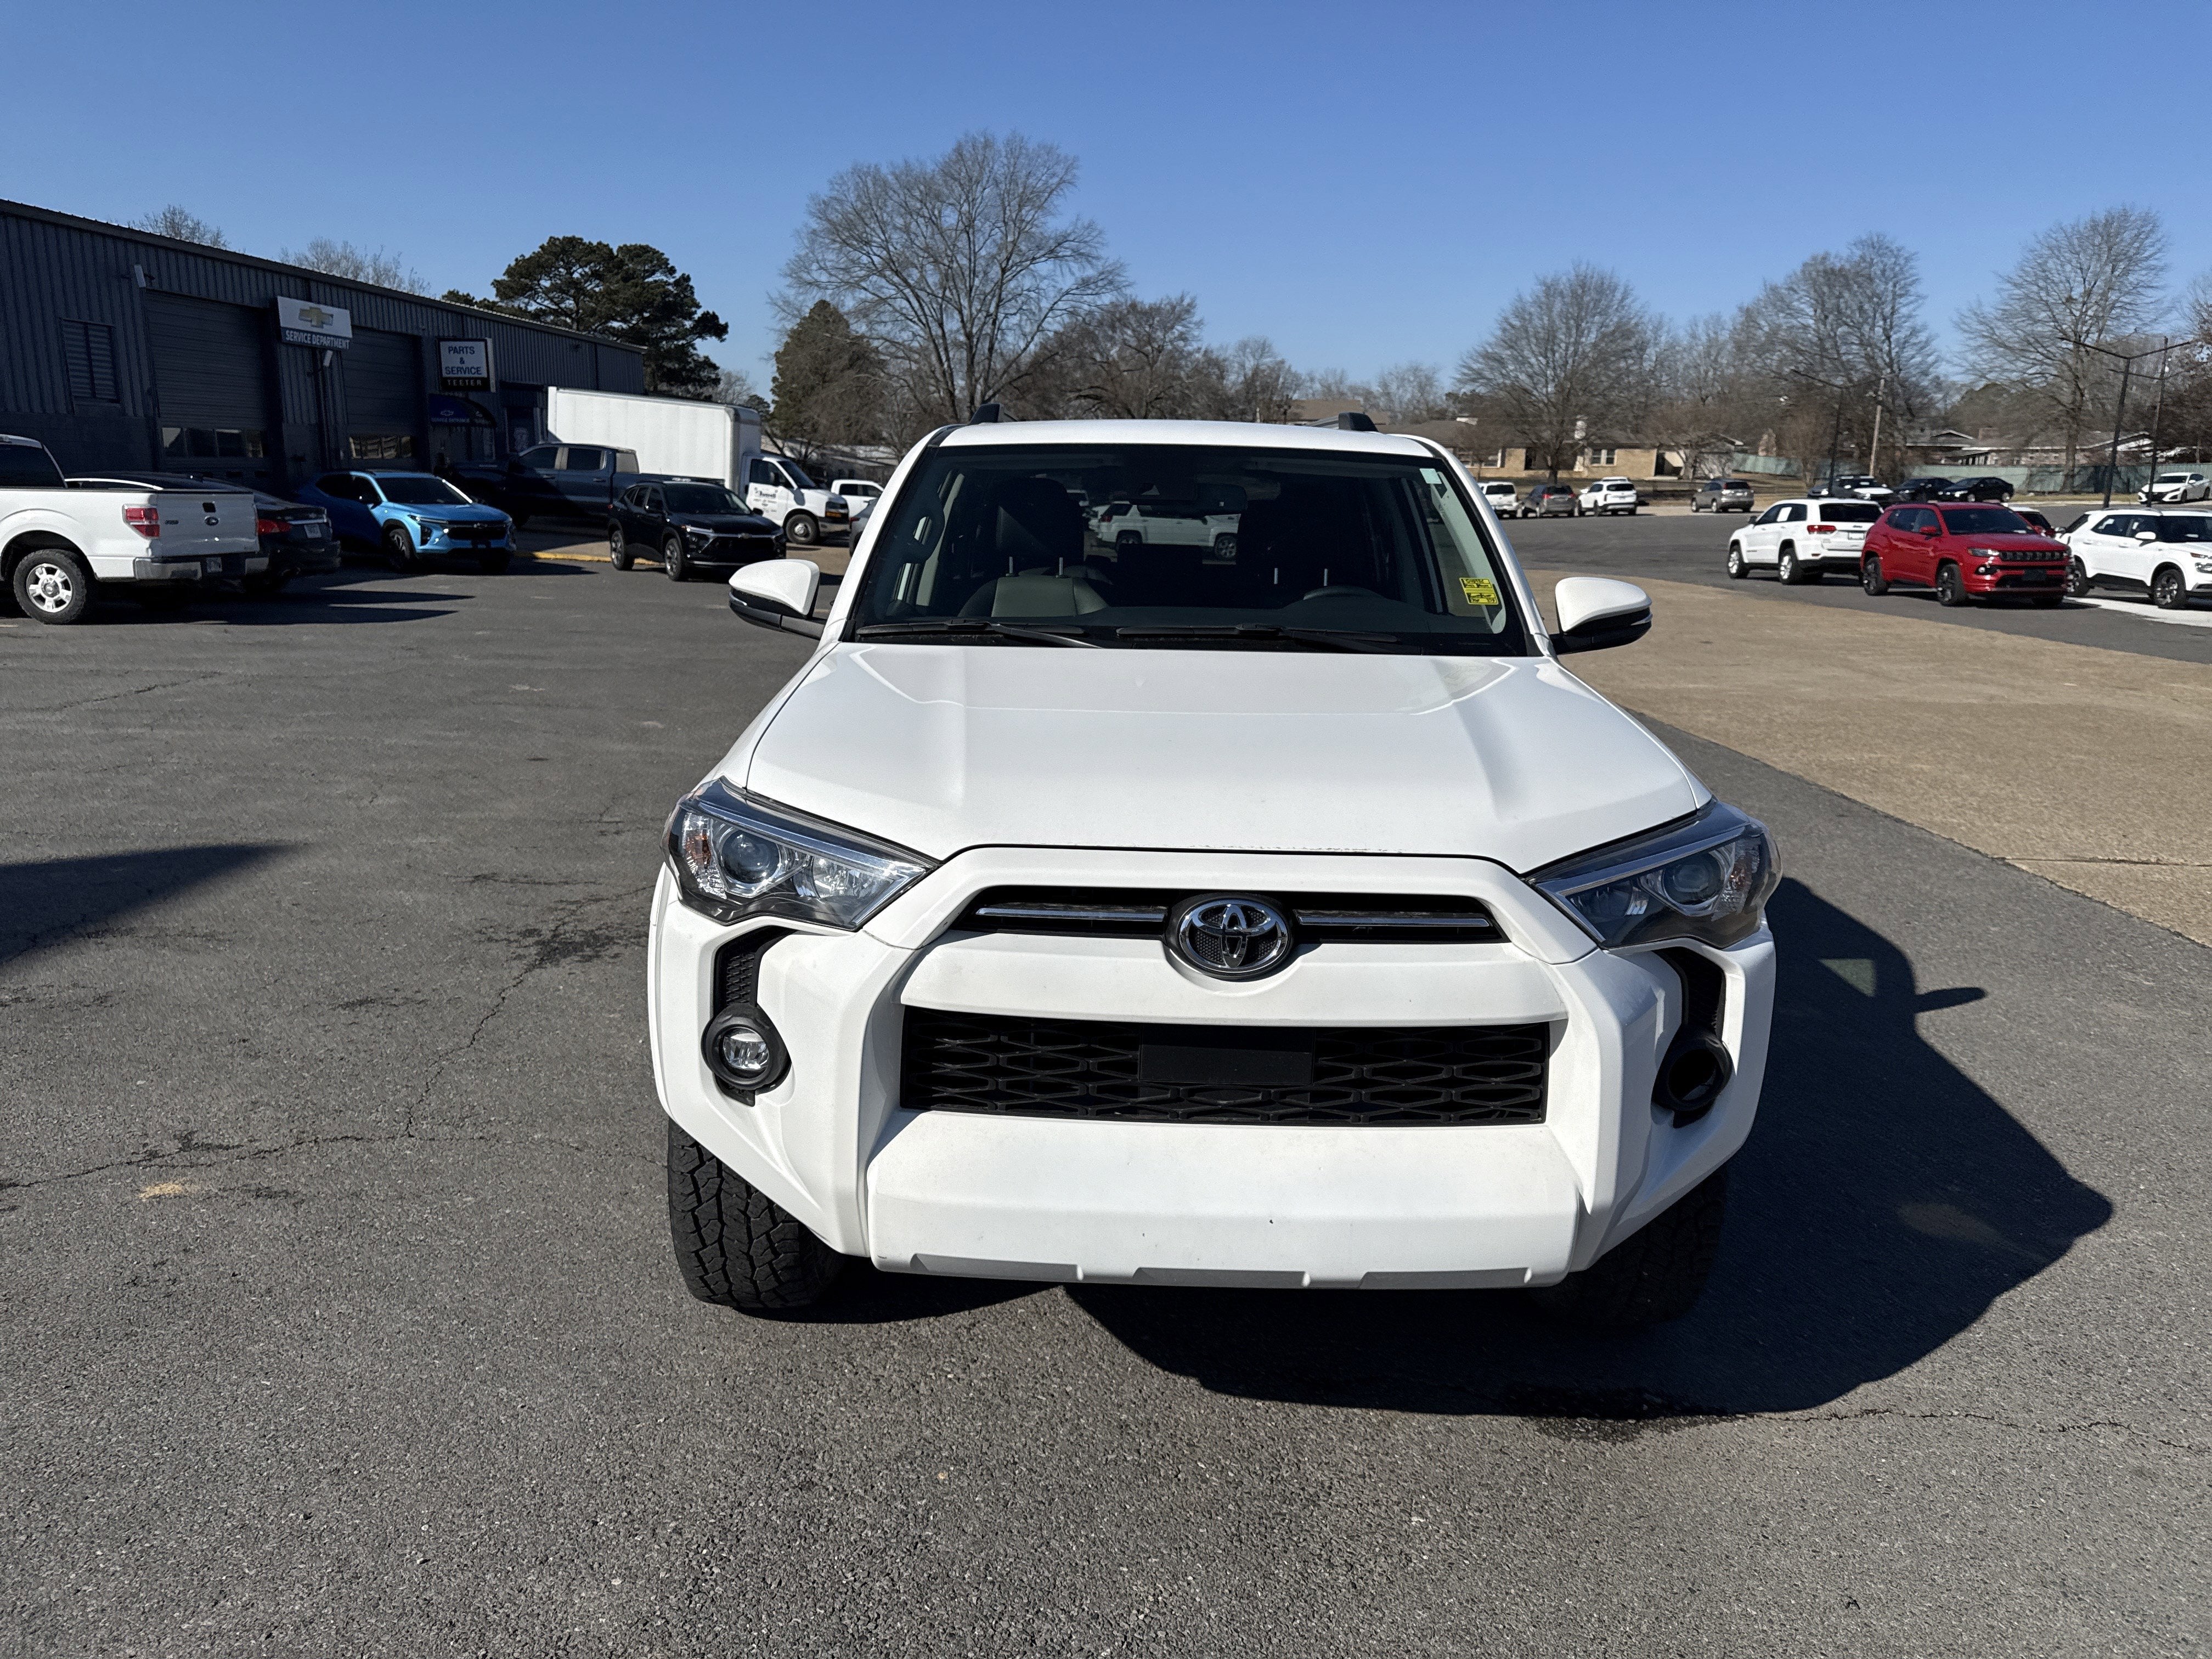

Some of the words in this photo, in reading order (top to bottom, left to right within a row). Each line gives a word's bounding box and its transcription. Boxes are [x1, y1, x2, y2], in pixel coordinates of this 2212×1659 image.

[286, 330, 311, 343] SERVICE
[312, 334, 349, 349] DEPARTMENT
[448, 346, 475, 355] PARTS
[459, 356, 465, 365] &
[445, 366, 482, 375] SERVICE
